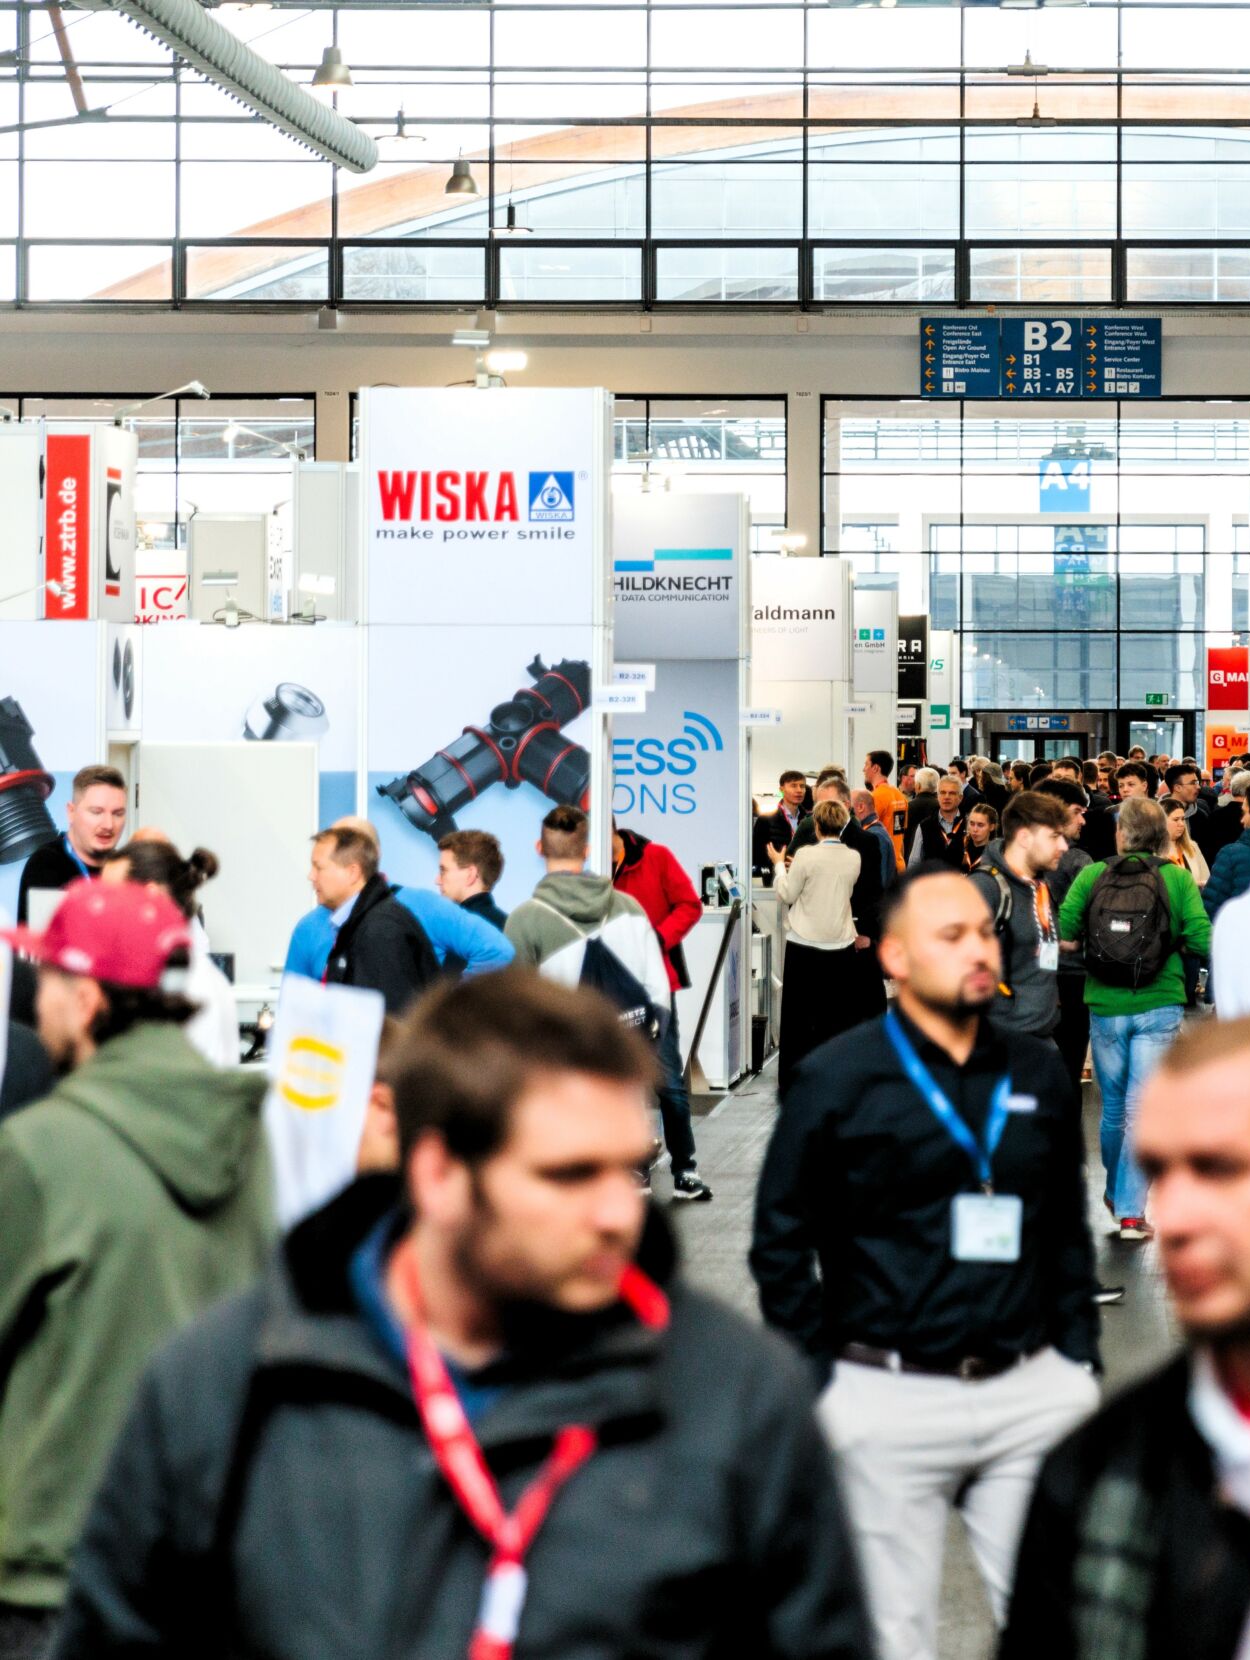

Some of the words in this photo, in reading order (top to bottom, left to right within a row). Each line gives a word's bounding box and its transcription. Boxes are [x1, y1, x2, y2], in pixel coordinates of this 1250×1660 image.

[1024, 320, 1072, 351] B2
[1023, 354, 1040, 366] B1
[1023, 368, 1042, 380] B3
[1056, 368, 1074, 380] B5
[1022, 382, 1041, 394] A1
[1055, 382, 1075, 394] A7
[1040, 462, 1091, 490] A4
[377, 470, 520, 522] WISKA
[535, 512, 568, 520] WISKA
[376, 526, 434, 540] make
[443, 528, 509, 542] power
[518, 526, 576, 540] smile
[58, 476, 77, 610] www.ztrb.de
[621, 594, 646, 602] DATA
[648, 594, 730, 602] COMMUNICATION
[752, 604, 835, 620] aldmann
[612, 738, 697, 776] ESS
[612, 783, 697, 815] ONS
